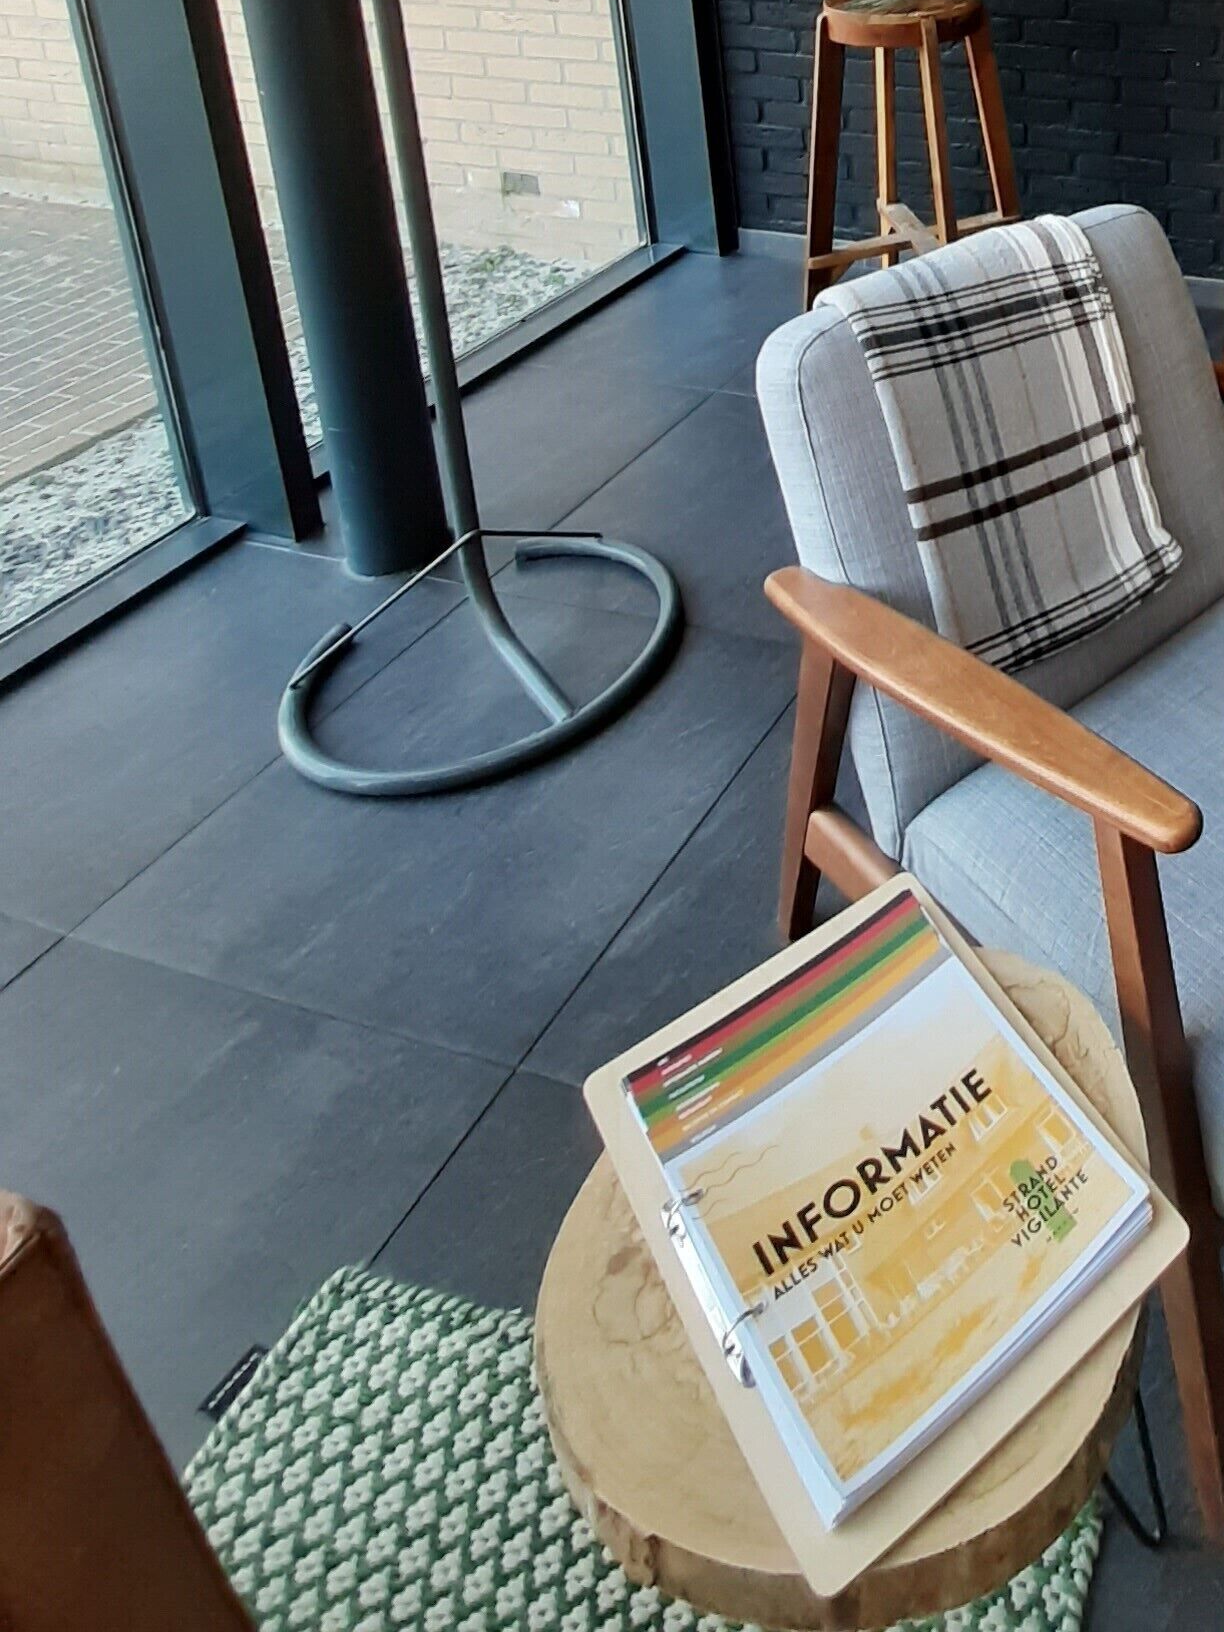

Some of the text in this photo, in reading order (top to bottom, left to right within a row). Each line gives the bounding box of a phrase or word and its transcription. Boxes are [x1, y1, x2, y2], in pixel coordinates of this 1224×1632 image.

[752, 1068, 992, 1277] INFORMATIE
[1003, 1156, 1058, 1212] STRAND
[1010, 1168, 1089, 1247] VIGILANTE
[1016, 1173, 1066, 1222] HOTEL
[774, 1142, 956, 1301] ALLES WAT U MOET WETEN
